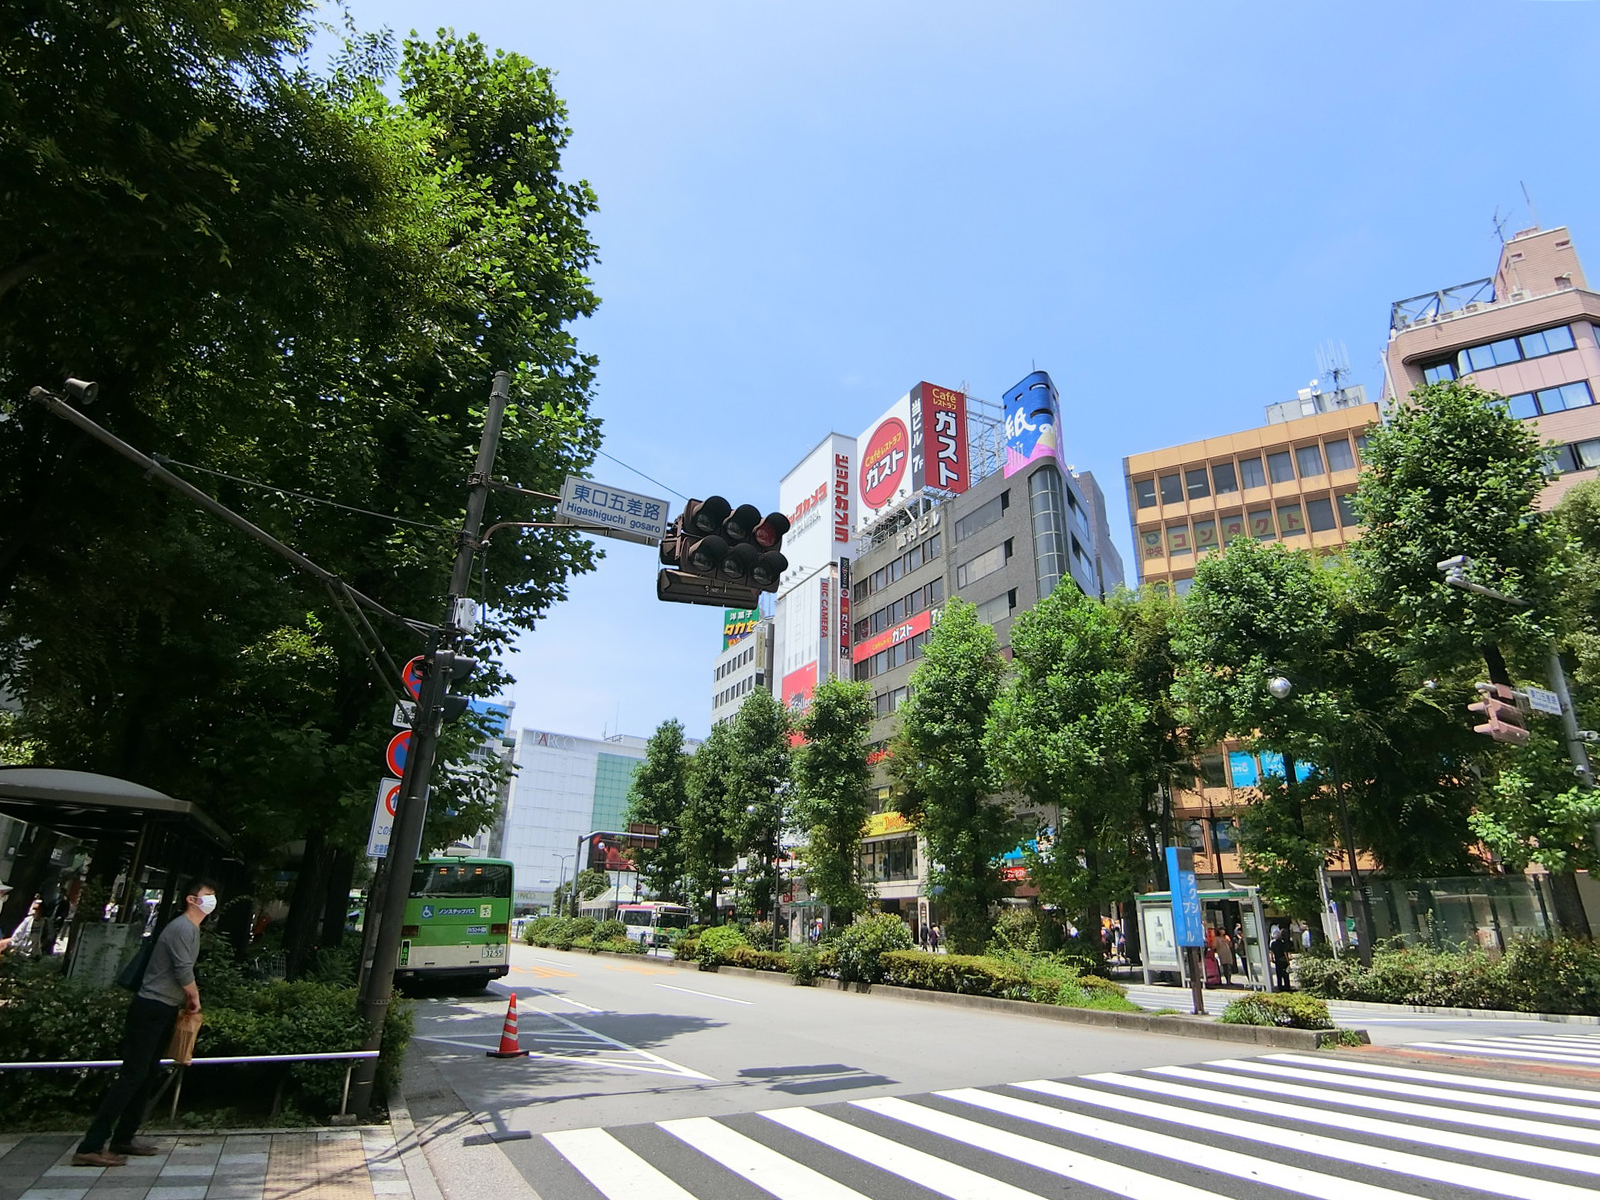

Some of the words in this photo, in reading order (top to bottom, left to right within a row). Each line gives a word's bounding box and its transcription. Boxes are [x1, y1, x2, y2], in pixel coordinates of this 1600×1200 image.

[932, 388, 957, 404] Café
[933, 398, 957, 410] レストラン
[911, 398, 923, 449] 当ビル
[912, 454, 924, 474] 7F
[935, 410, 958, 487] ガスト
[866, 447, 904, 493] ガスト
[572, 484, 661, 521] 東口五差路
[786, 481, 828, 526] ックカメラ
[834, 453, 849, 544] ビックカメラ
[566, 501, 627, 525] Higashiguchi
[629, 519, 661, 533] gosaro
[1173, 513, 1300, 549] コンタクト
[820, 582, 829, 597] BIC
[723, 620, 758, 636] タカセ
[820, 599, 829, 638] CAMERA
[841, 613, 850, 636] ガスト
[892, 623, 914, 643] ガスト
[532, 731, 577, 750] PARCO
[1186, 874, 1199, 928] タクシー
[1182, 901, 1195, 943] プール
